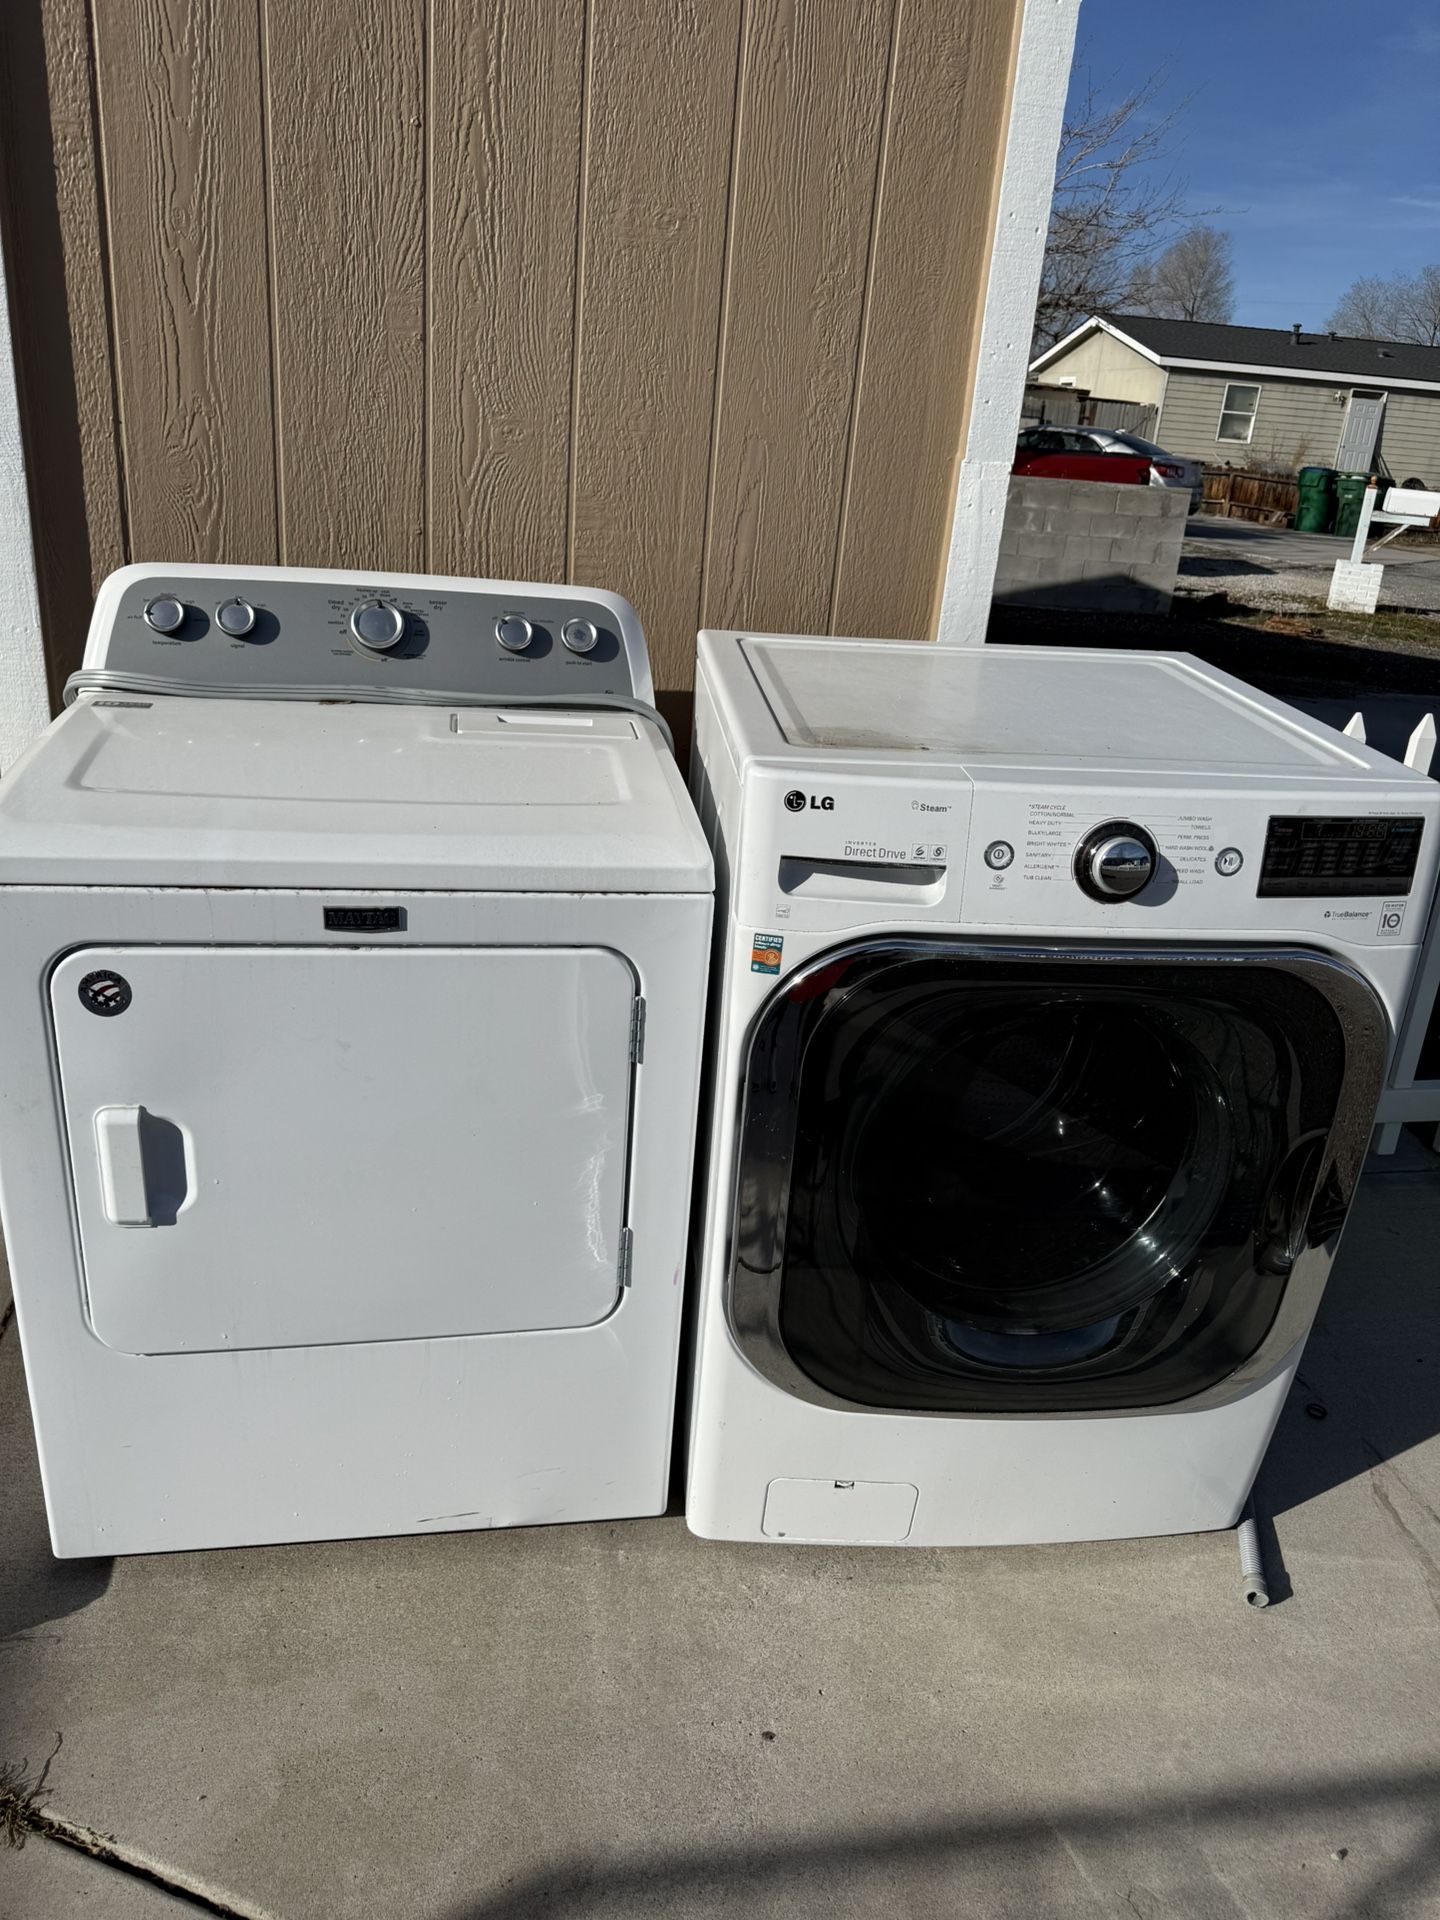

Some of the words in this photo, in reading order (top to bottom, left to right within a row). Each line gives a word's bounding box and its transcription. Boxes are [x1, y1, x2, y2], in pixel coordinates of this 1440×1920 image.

[810, 795, 835, 811] LG
[844, 845, 877, 858] Direct
[878, 847, 907, 860] Drive
[327, 910, 397, 926] MAYTAG
[1381, 913, 1401, 929] 10
[755, 934, 783, 943] CERTIFIED
